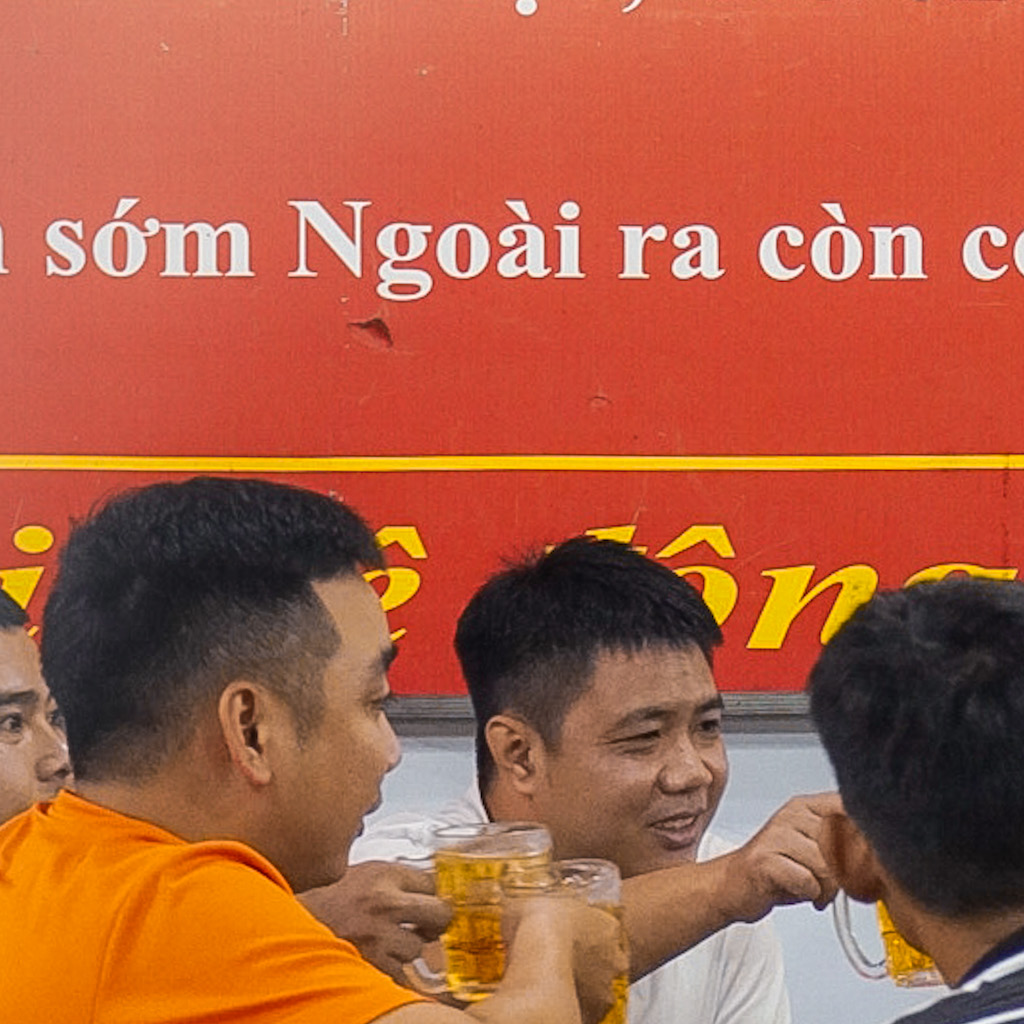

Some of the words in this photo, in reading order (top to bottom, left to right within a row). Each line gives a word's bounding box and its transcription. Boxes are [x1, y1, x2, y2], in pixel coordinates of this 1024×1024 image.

[45, 198, 256, 278] sớm
[288, 200, 586, 302] Ngoài
[618, 224, 726, 280] ra
[758, 202, 929, 281] còn
